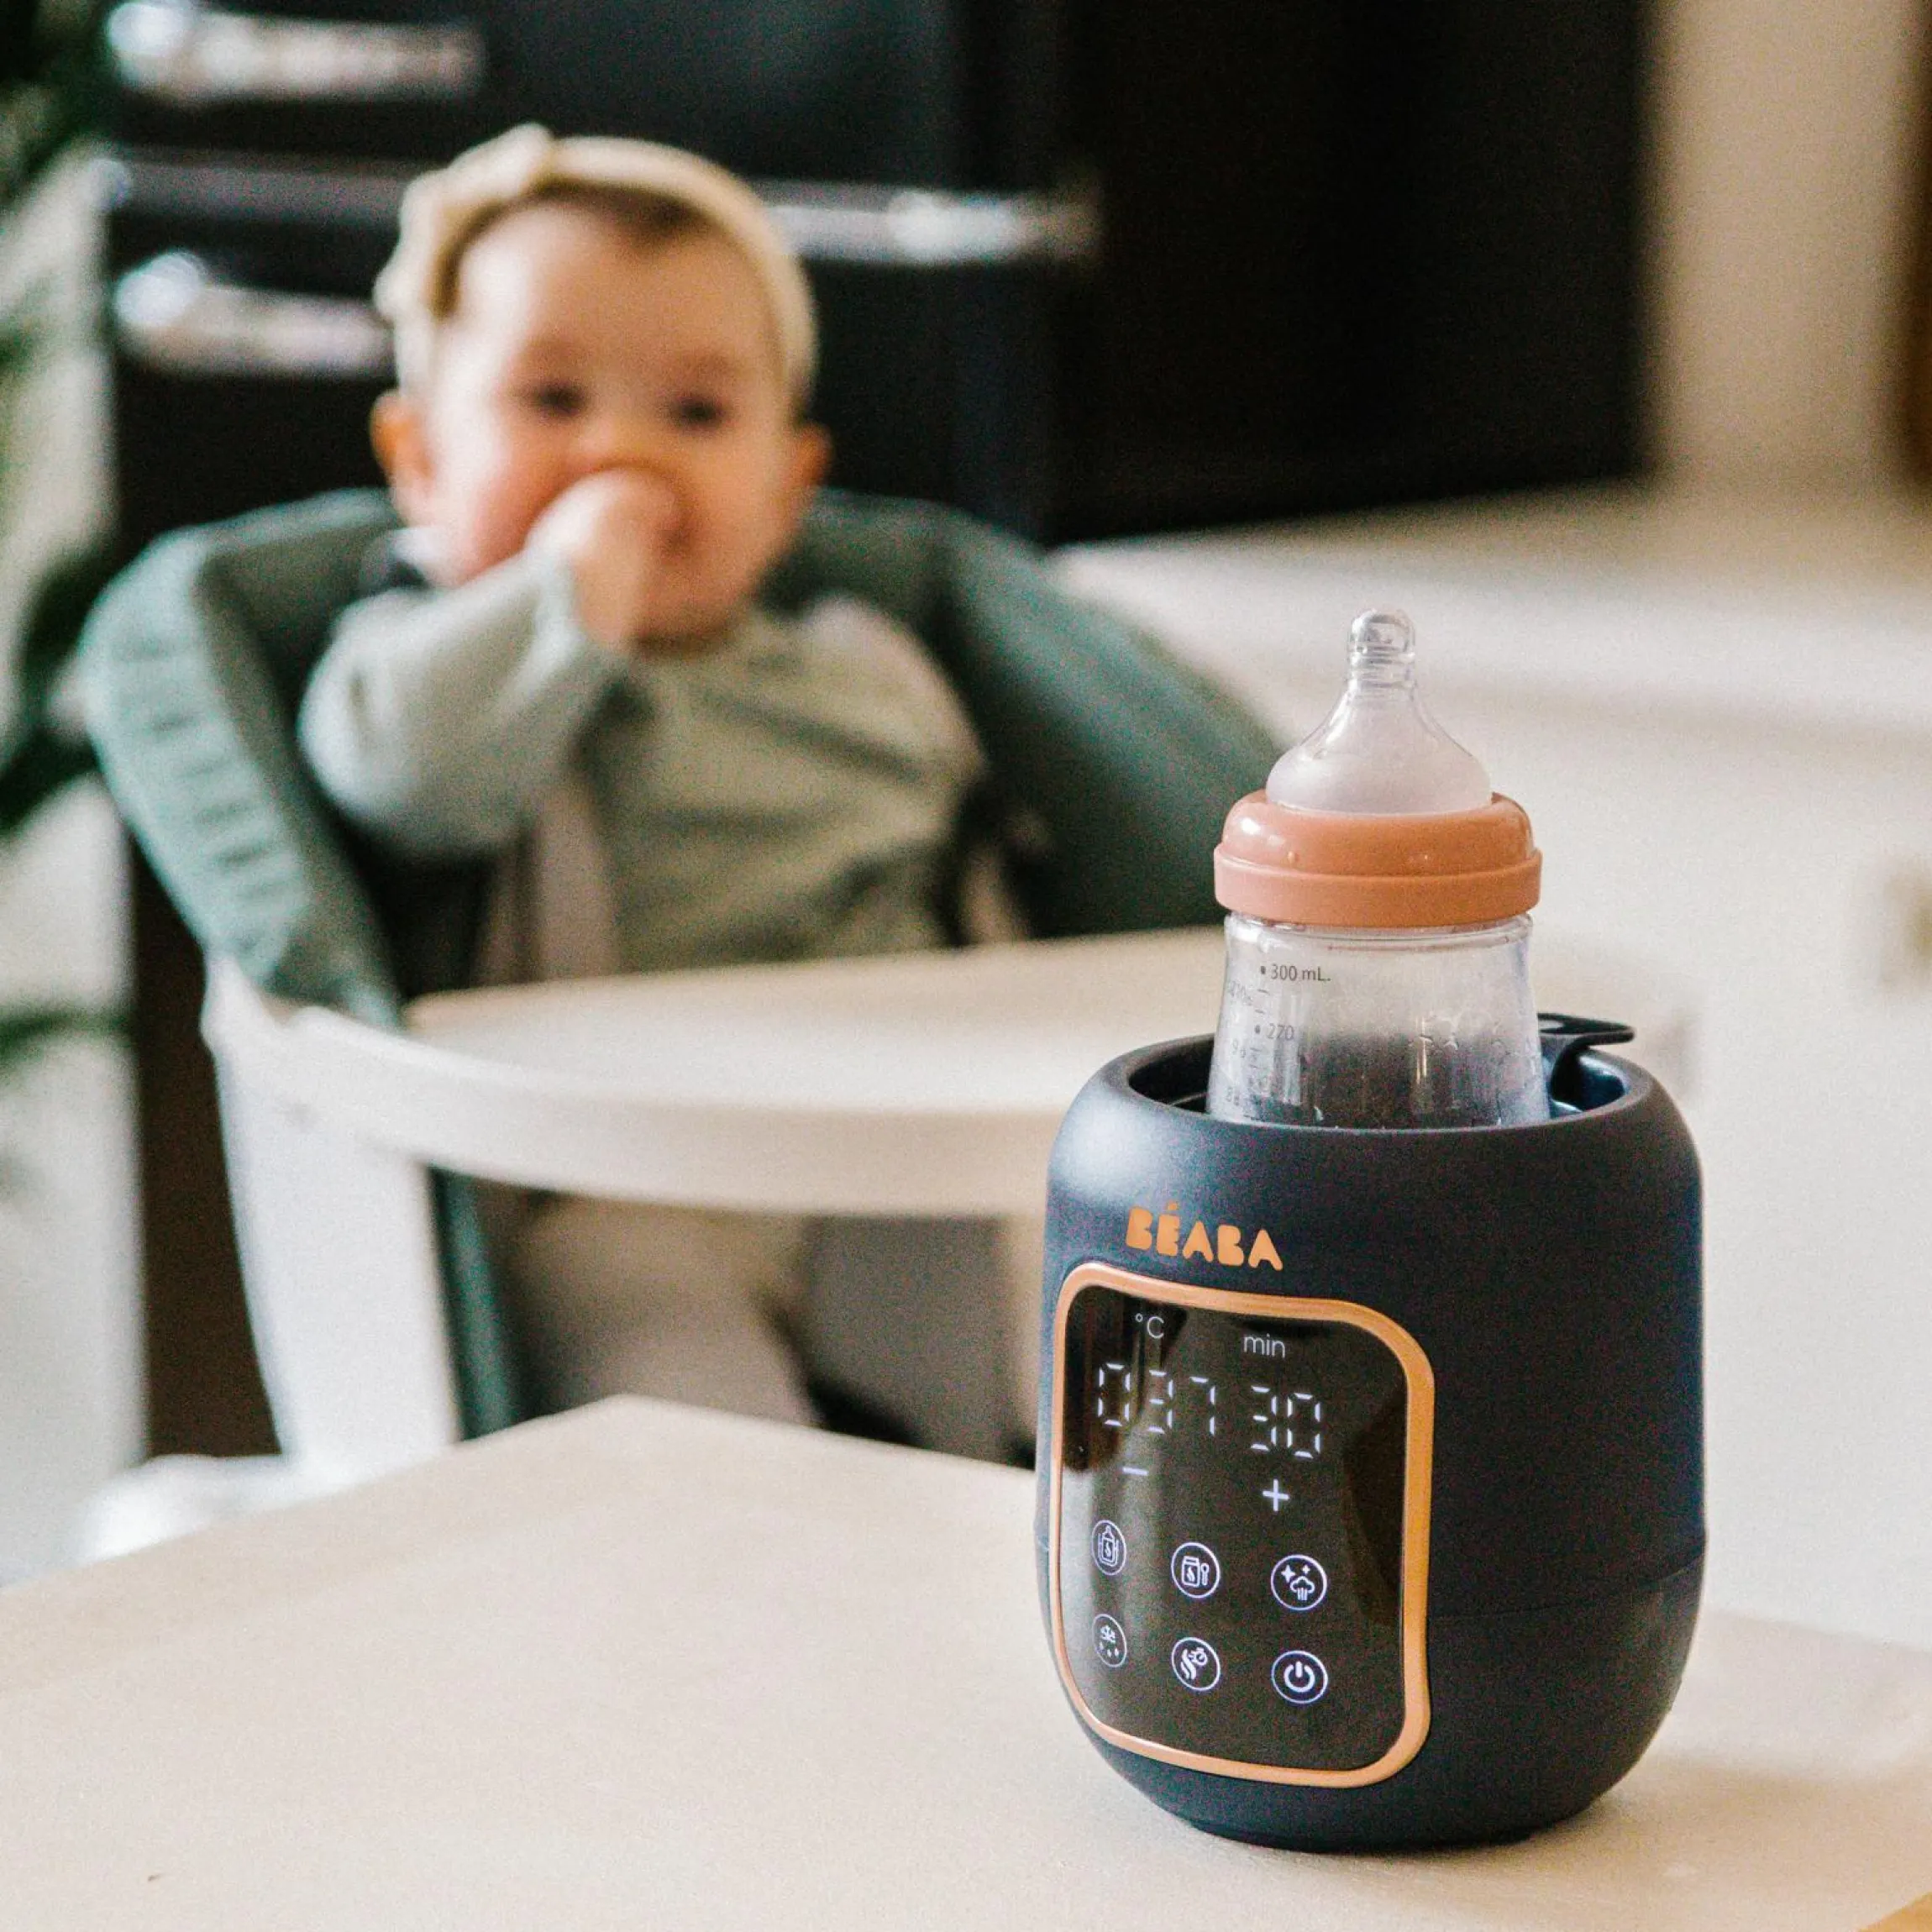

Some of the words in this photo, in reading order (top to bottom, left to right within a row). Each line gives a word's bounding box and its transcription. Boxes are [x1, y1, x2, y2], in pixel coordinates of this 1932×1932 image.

[1270, 963, 1298, 981] 300
[1266, 1023, 1294, 1041] 270
[1125, 1200, 1284, 1271] BÉABA
[1243, 1333, 1286, 1358] min
[1251, 1386, 1321, 1459] 30
